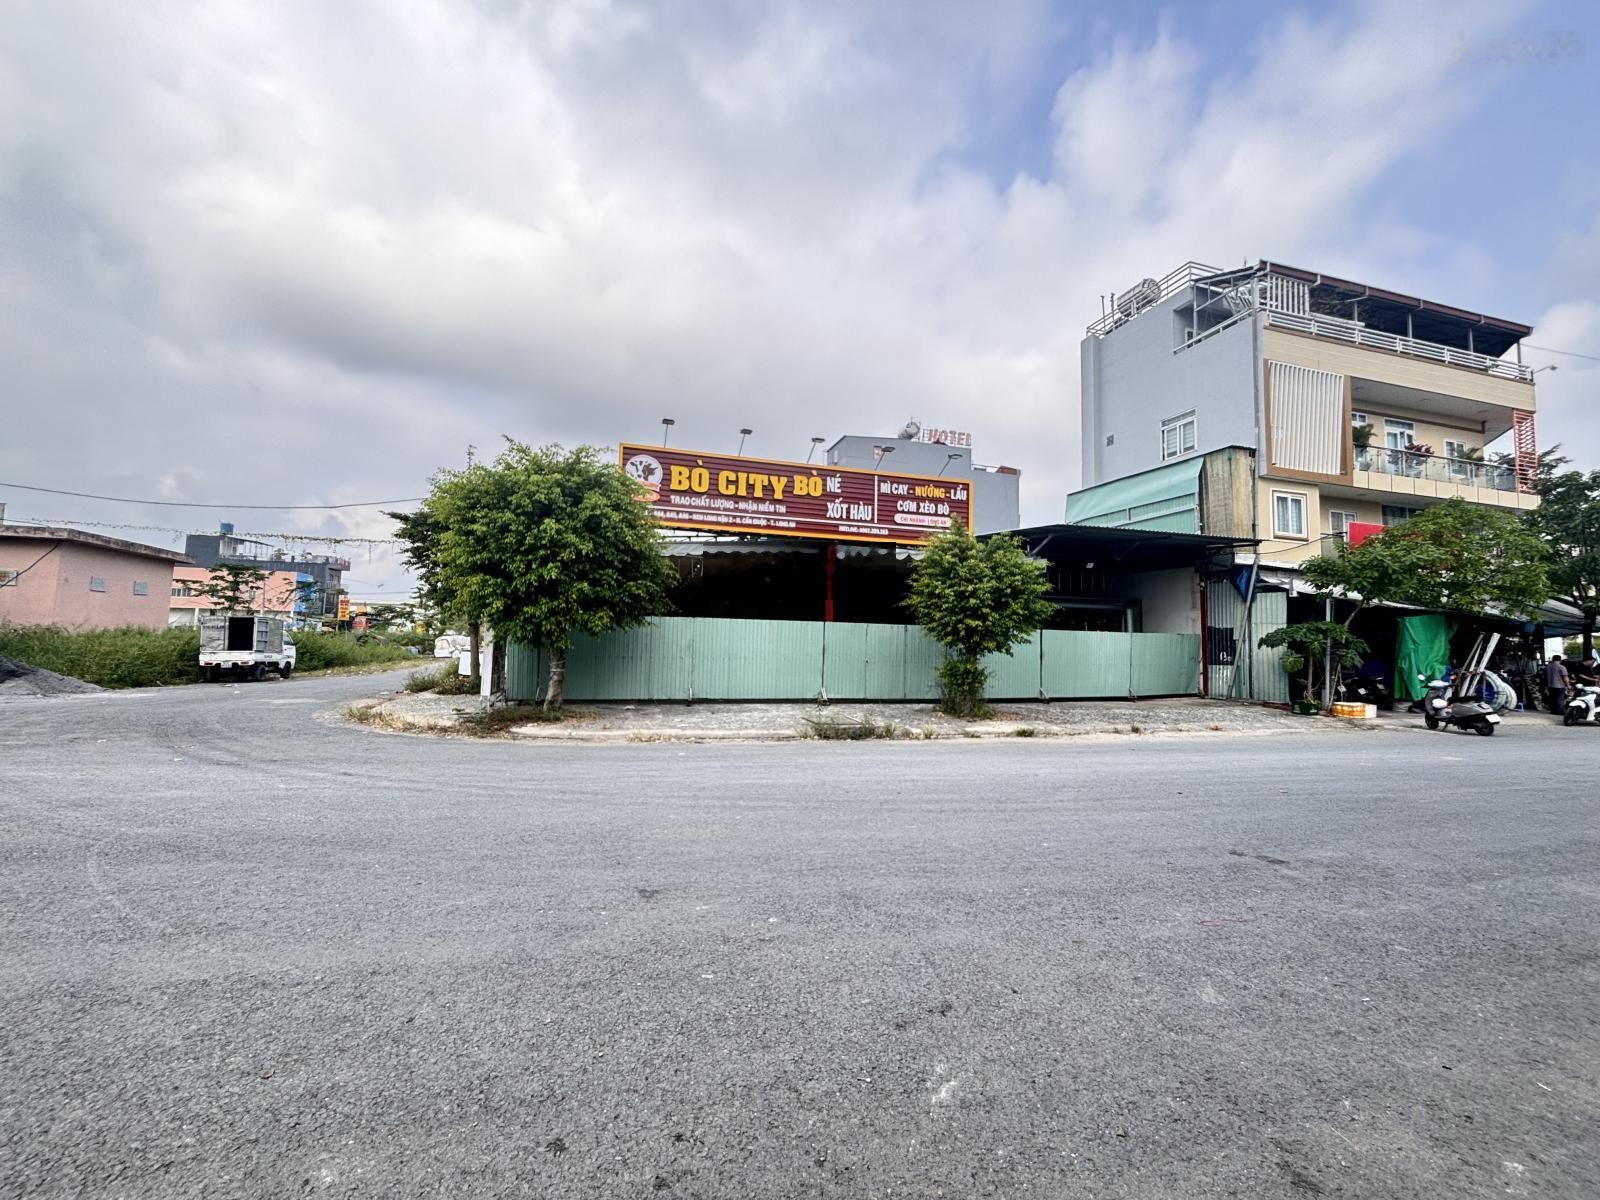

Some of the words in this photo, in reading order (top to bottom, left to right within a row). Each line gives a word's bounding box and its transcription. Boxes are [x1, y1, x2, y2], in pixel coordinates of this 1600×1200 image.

[928, 428, 971, 446] HOTEL
[670, 459, 710, 493] BÒ
[718, 470, 788, 500] CITY
[793, 470, 823, 497] BÒ
[826, 473, 842, 493] NÉ
[880, 480, 891, 494] MÌ
[891, 483, 909, 495] CAY
[915, 484, 945, 499] NƯỚNG
[950, 485, 967, 500] LẨU
[670, 495, 691, 505] TRAO
[691, 495, 710, 508] CHẤT
[710, 499, 734, 510] LƯỢNG
[775, 504, 786, 514] TIN
[826, 497, 849, 519] XỐT
[850, 501, 872, 521] HÀU
[896, 500, 917, 512] CƠM
[919, 500, 936, 513] XÈO
[937, 502, 950, 515] BÒ
